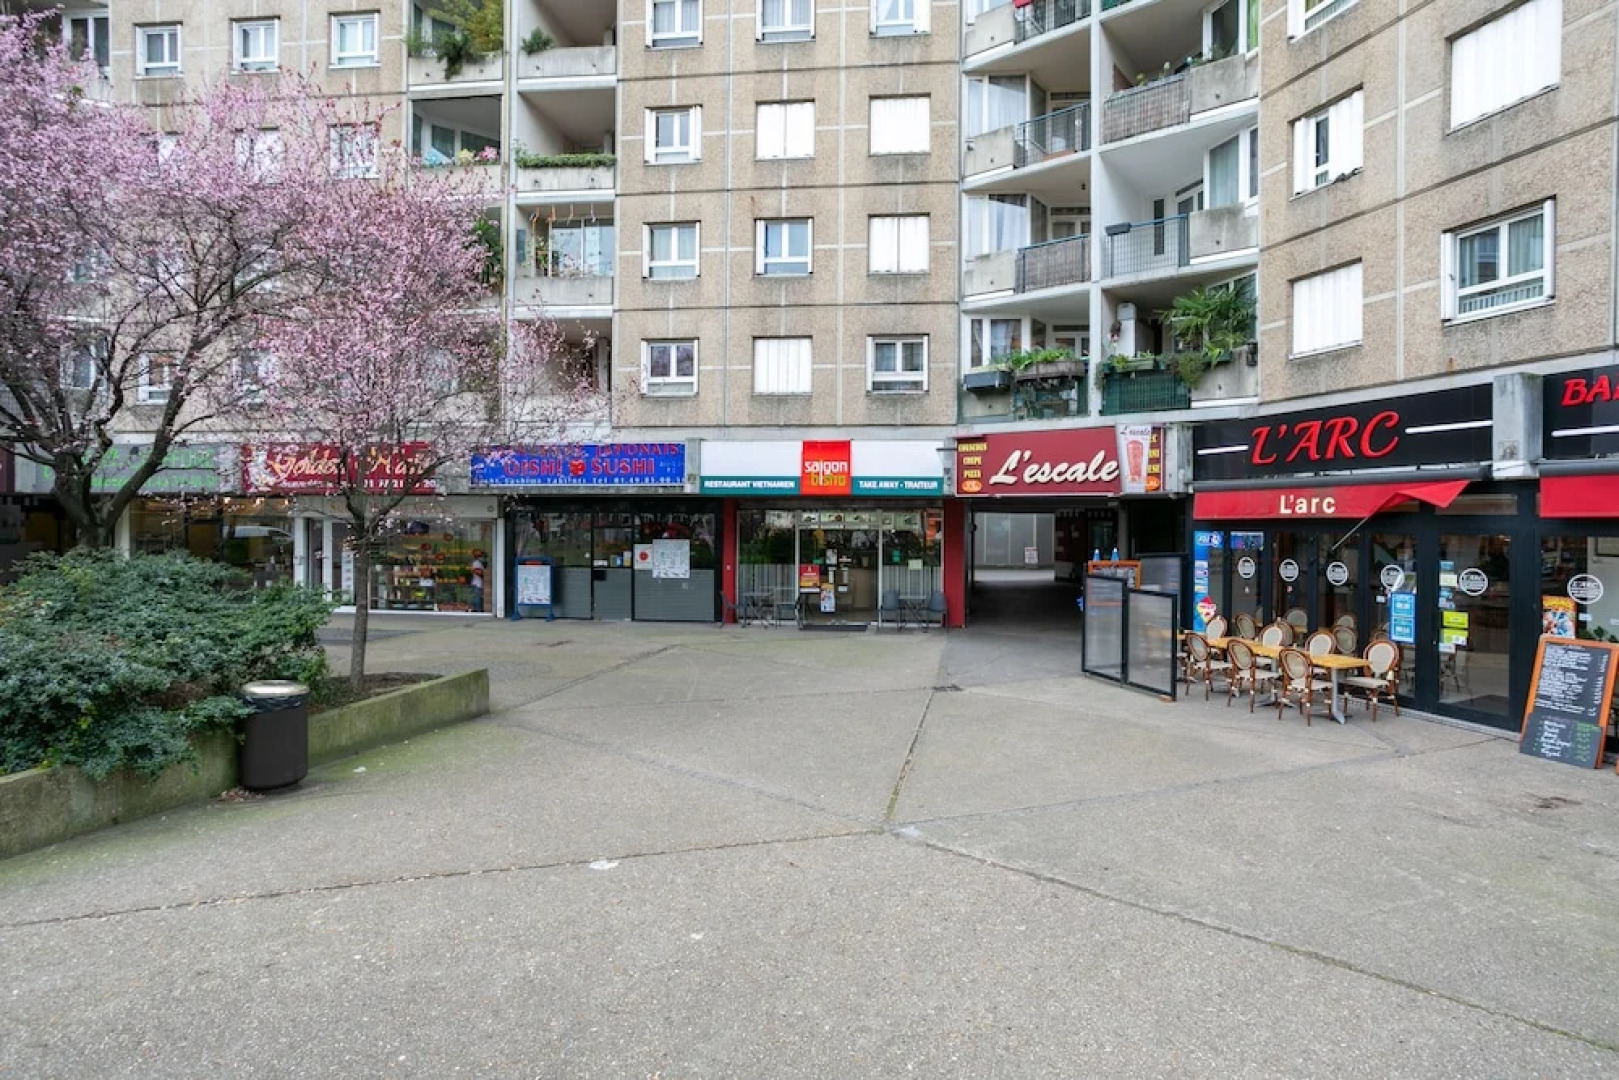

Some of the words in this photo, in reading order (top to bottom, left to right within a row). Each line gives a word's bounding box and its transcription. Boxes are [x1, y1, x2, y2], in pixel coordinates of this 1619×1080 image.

[1251, 411, 1400, 465] L'ARC
[591, 458, 654, 476] SUSHI
[805, 458, 848, 475] saigon
[989, 450, 1119, 485] L'escale
[704, 480, 750, 488] RESTAURANT
[752, 480, 796, 488] VIETNAMIEN
[859, 481, 877, 489] TAKE
[878, 481, 898, 489] AWAY
[904, 481, 938, 489] TRAITEUR
[1279, 494, 1336, 514] L'arc
